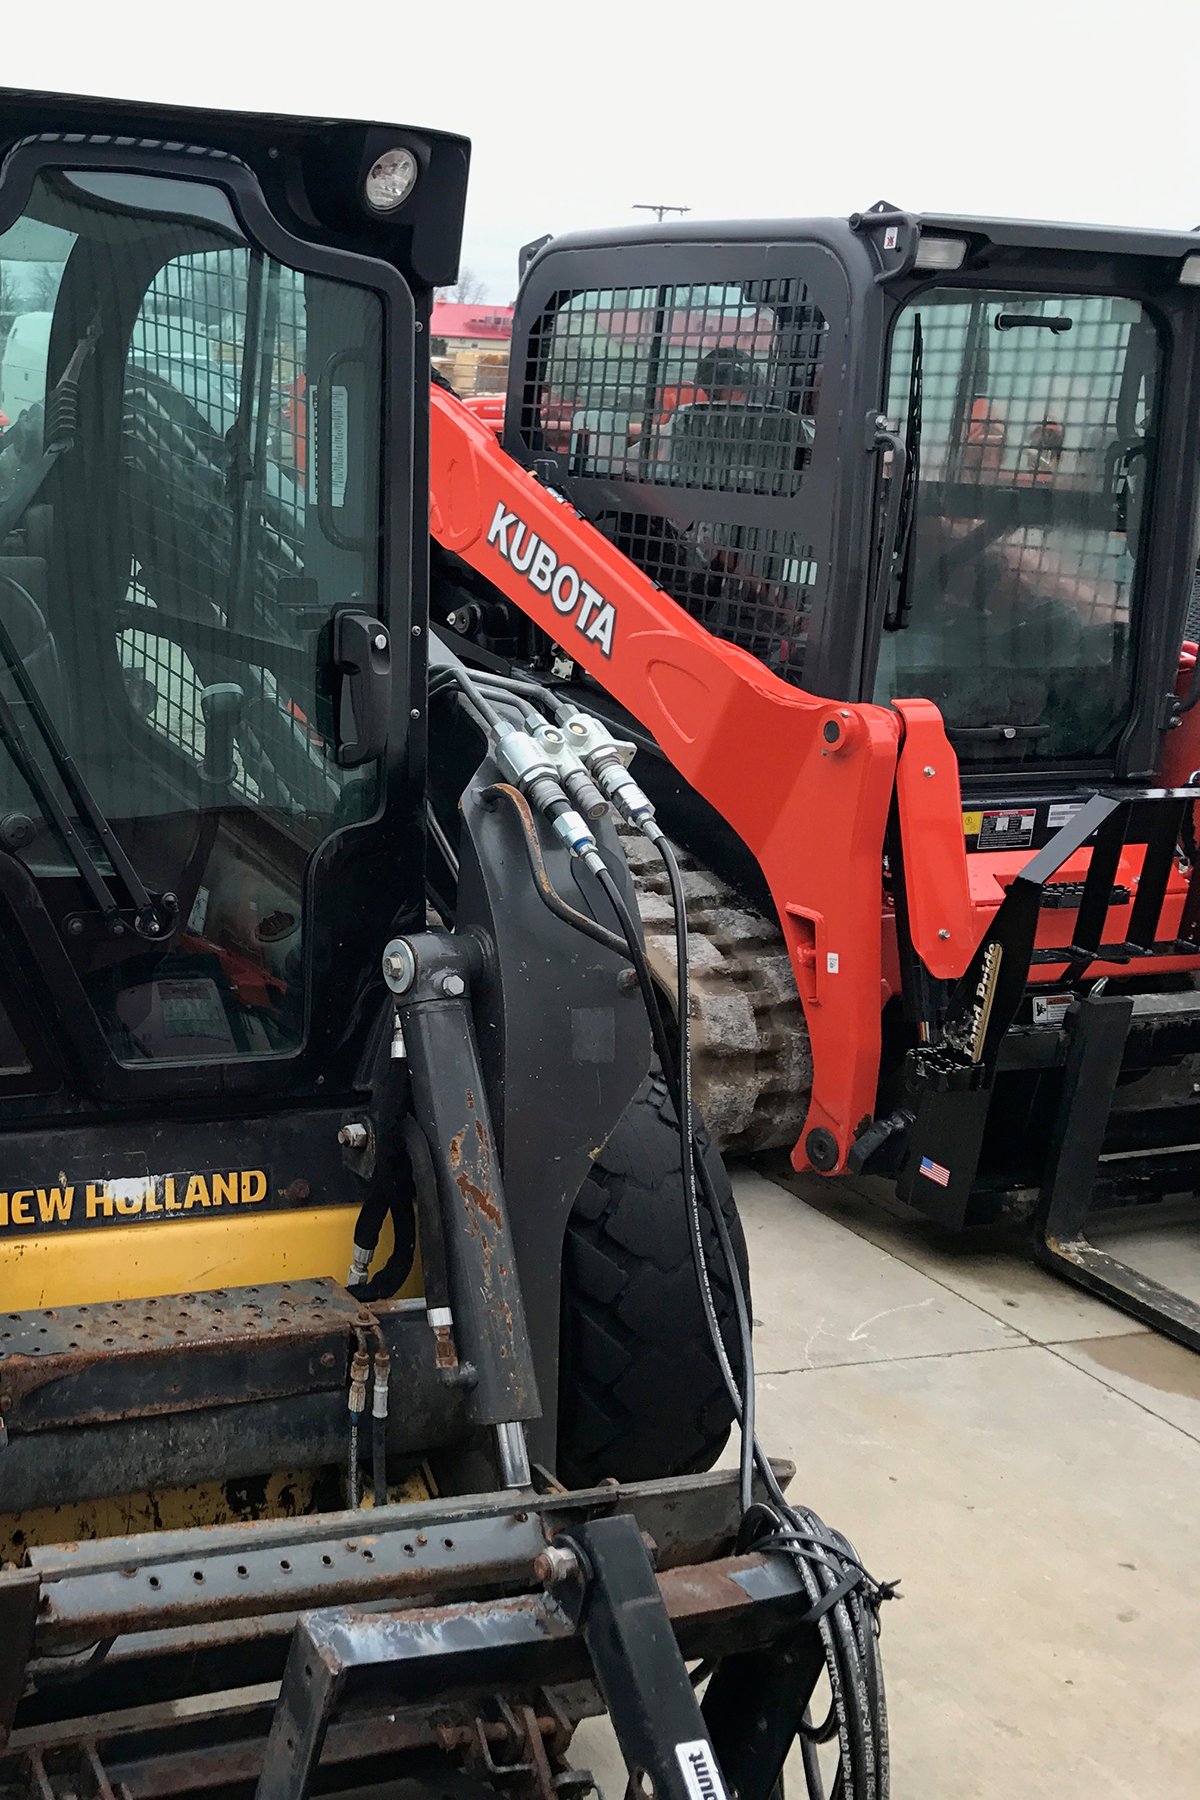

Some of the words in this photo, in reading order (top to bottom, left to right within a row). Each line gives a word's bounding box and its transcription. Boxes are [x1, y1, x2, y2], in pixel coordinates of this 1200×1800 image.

[486, 500, 617, 656] KUBOTA
[963, 1003, 983, 1057] Land
[975, 942, 996, 999] Pride
[85, 1169, 268, 1219] HOLLAND
[836, 1701, 846, 1723] WP
[841, 1753, 852, 1780] MPa
[864, 1735, 875, 1774] MSHA
